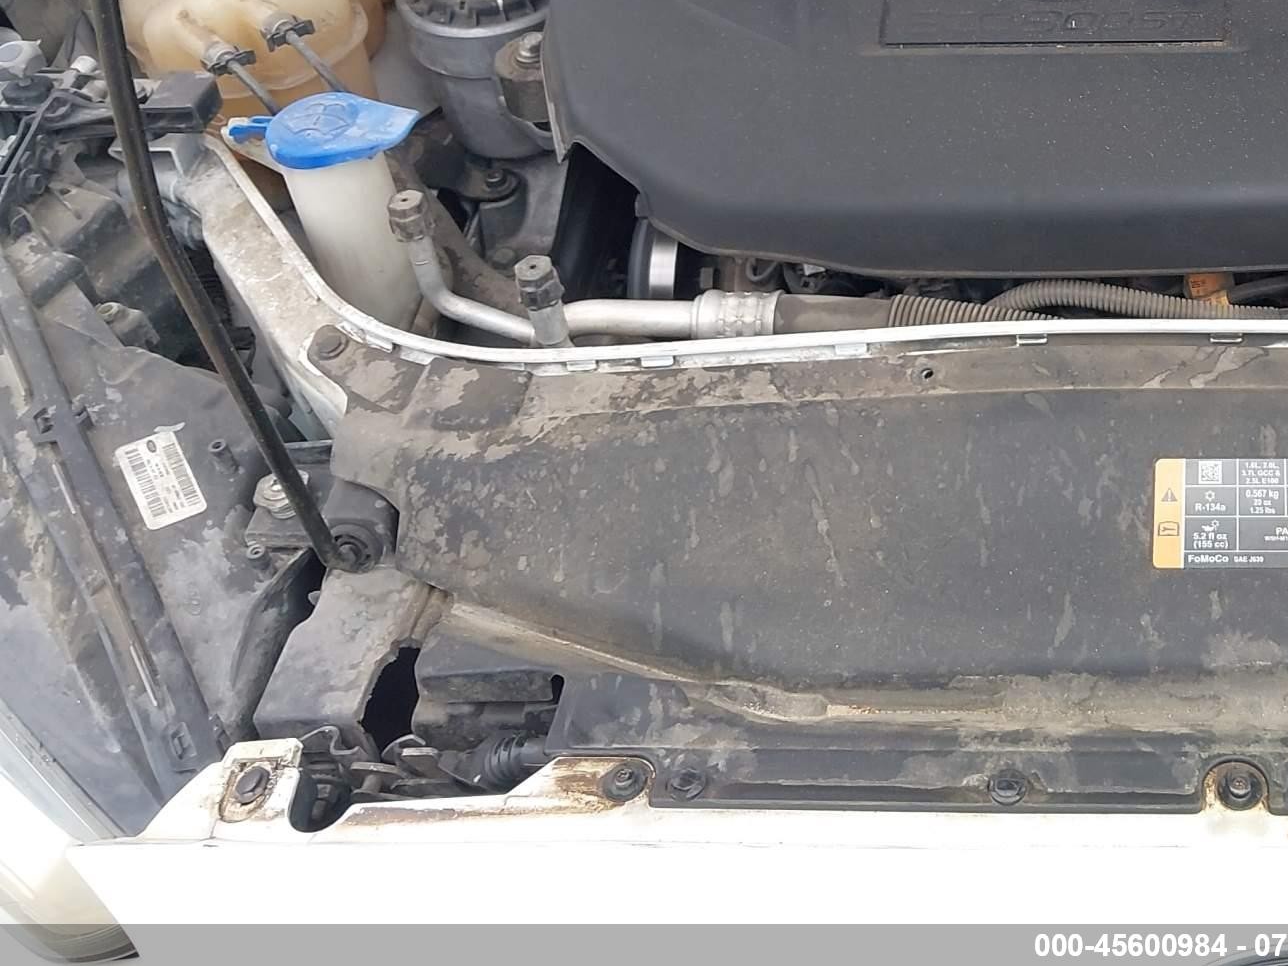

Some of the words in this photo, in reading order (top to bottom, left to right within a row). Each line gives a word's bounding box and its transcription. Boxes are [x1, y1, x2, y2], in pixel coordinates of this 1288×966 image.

[1245, 490, 1267, 498] 0.567
[1268, 490, 1279, 500] kg
[1195, 502, 1226, 512] R-134a
[1193, 532, 1207, 540] 5.2
[1193, 540, 1212, 549] (155
[1214, 540, 1229, 549] cc)
[1188, 554, 1229, 563] FoMoCo
